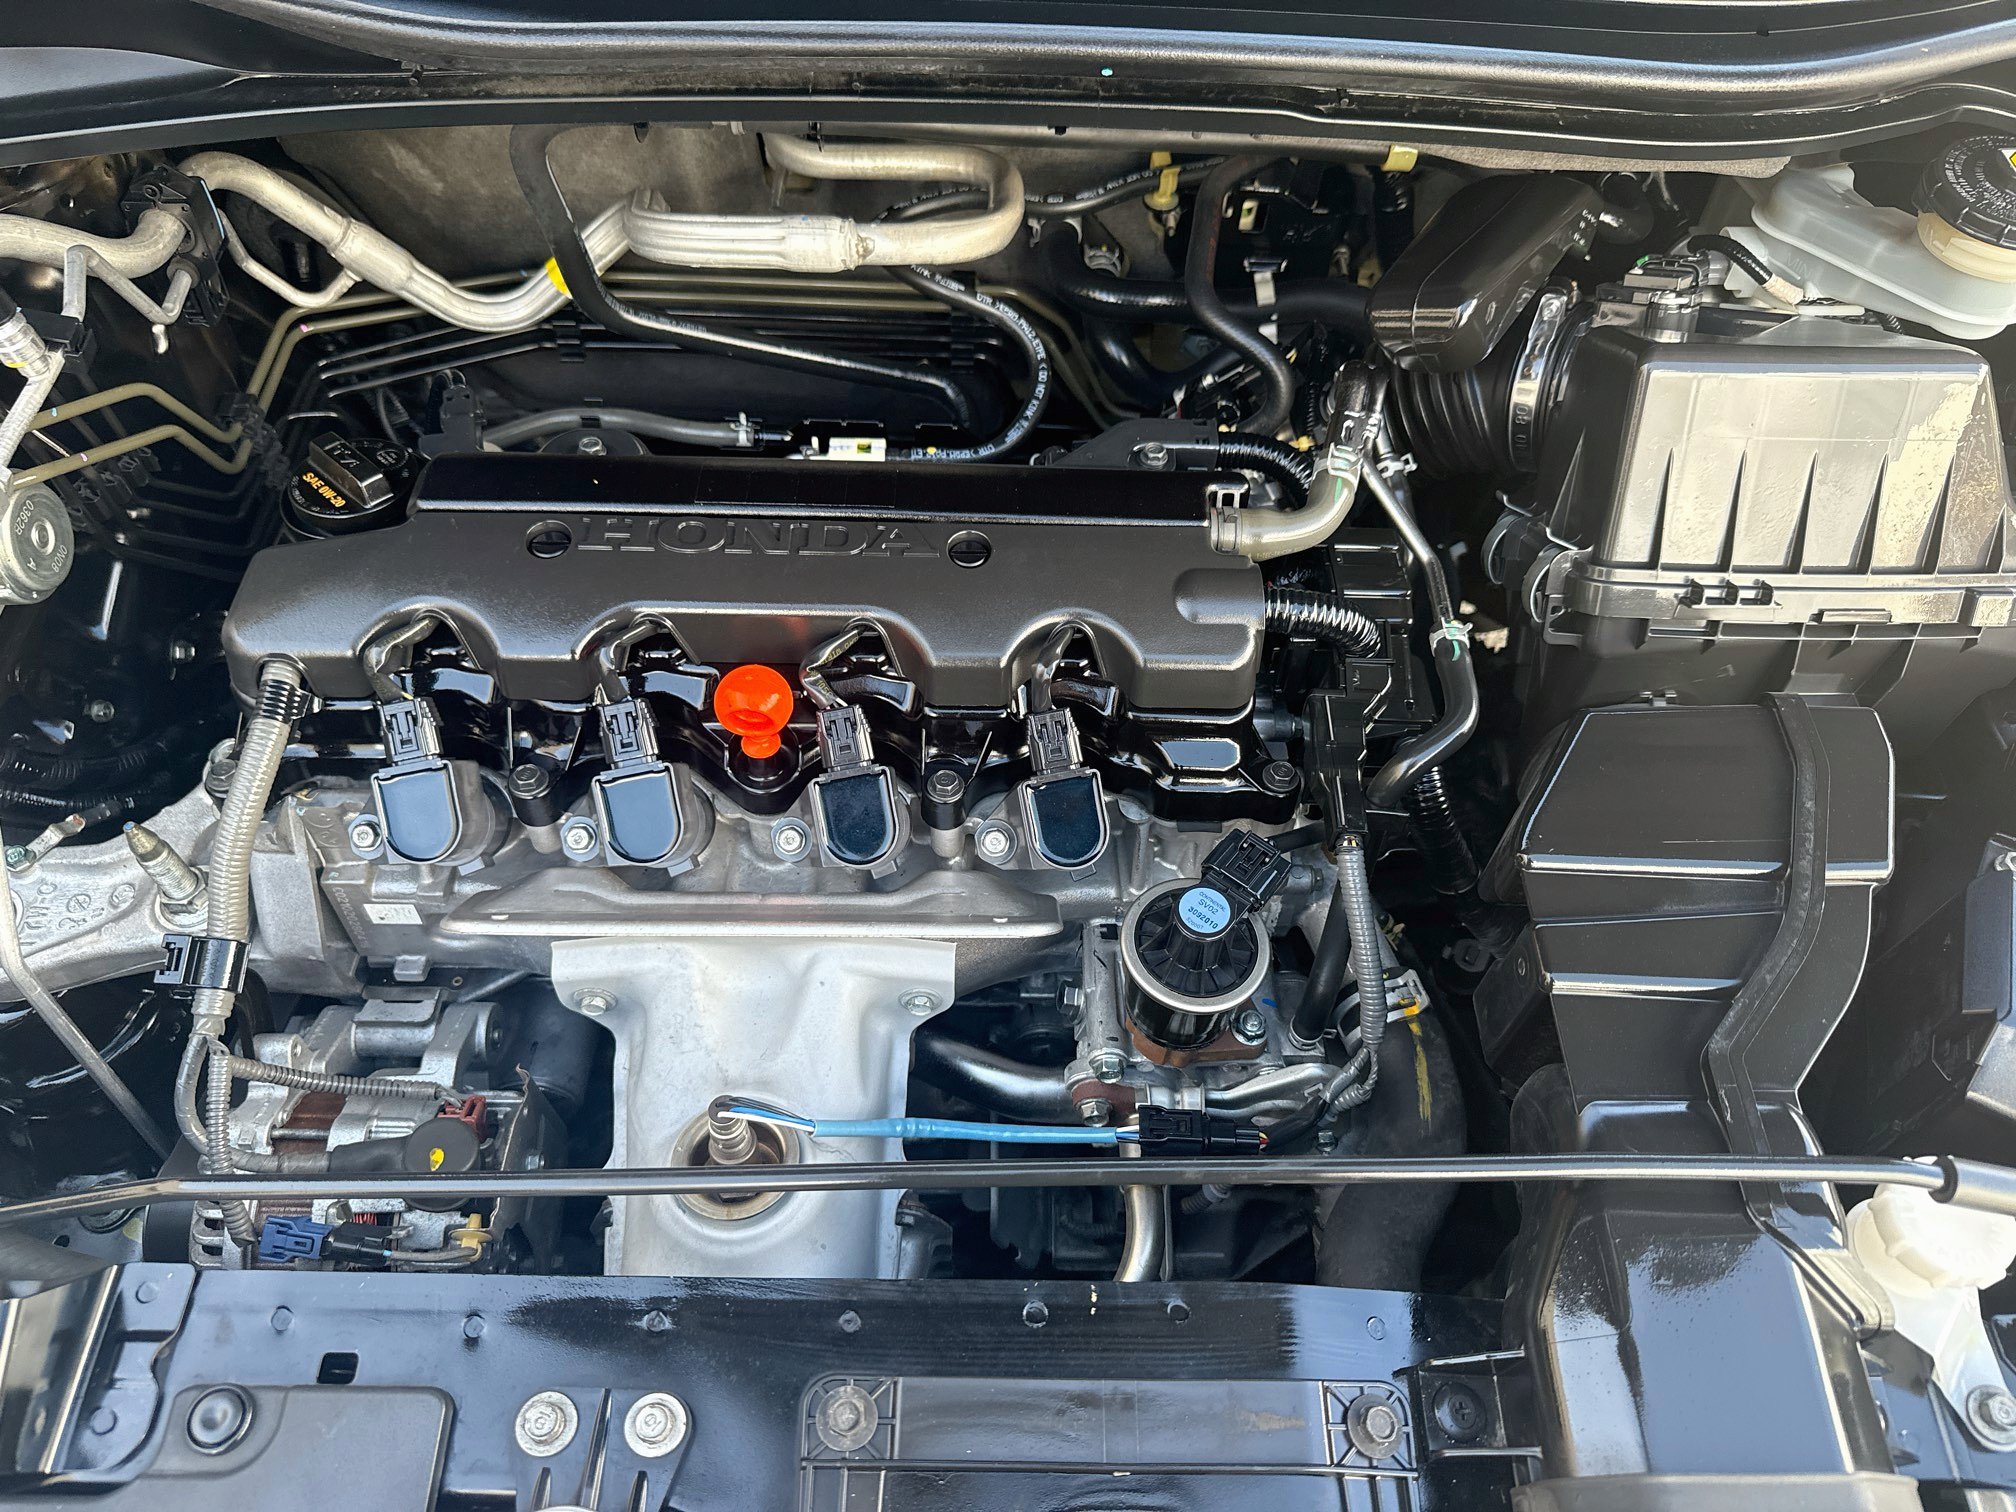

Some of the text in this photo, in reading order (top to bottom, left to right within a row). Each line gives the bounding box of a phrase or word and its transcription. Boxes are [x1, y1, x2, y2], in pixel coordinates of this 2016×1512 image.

[1037, 370, 1049, 383] DO
[1034, 383, 1046, 400] NOT
[1022, 399, 1040, 420] KINK
[302, 471, 325, 490] SAE
[577, 517, 941, 557] HONDA
[26, 557, 37, 571] A
[1187, 906, 1219, 930] 3092010
